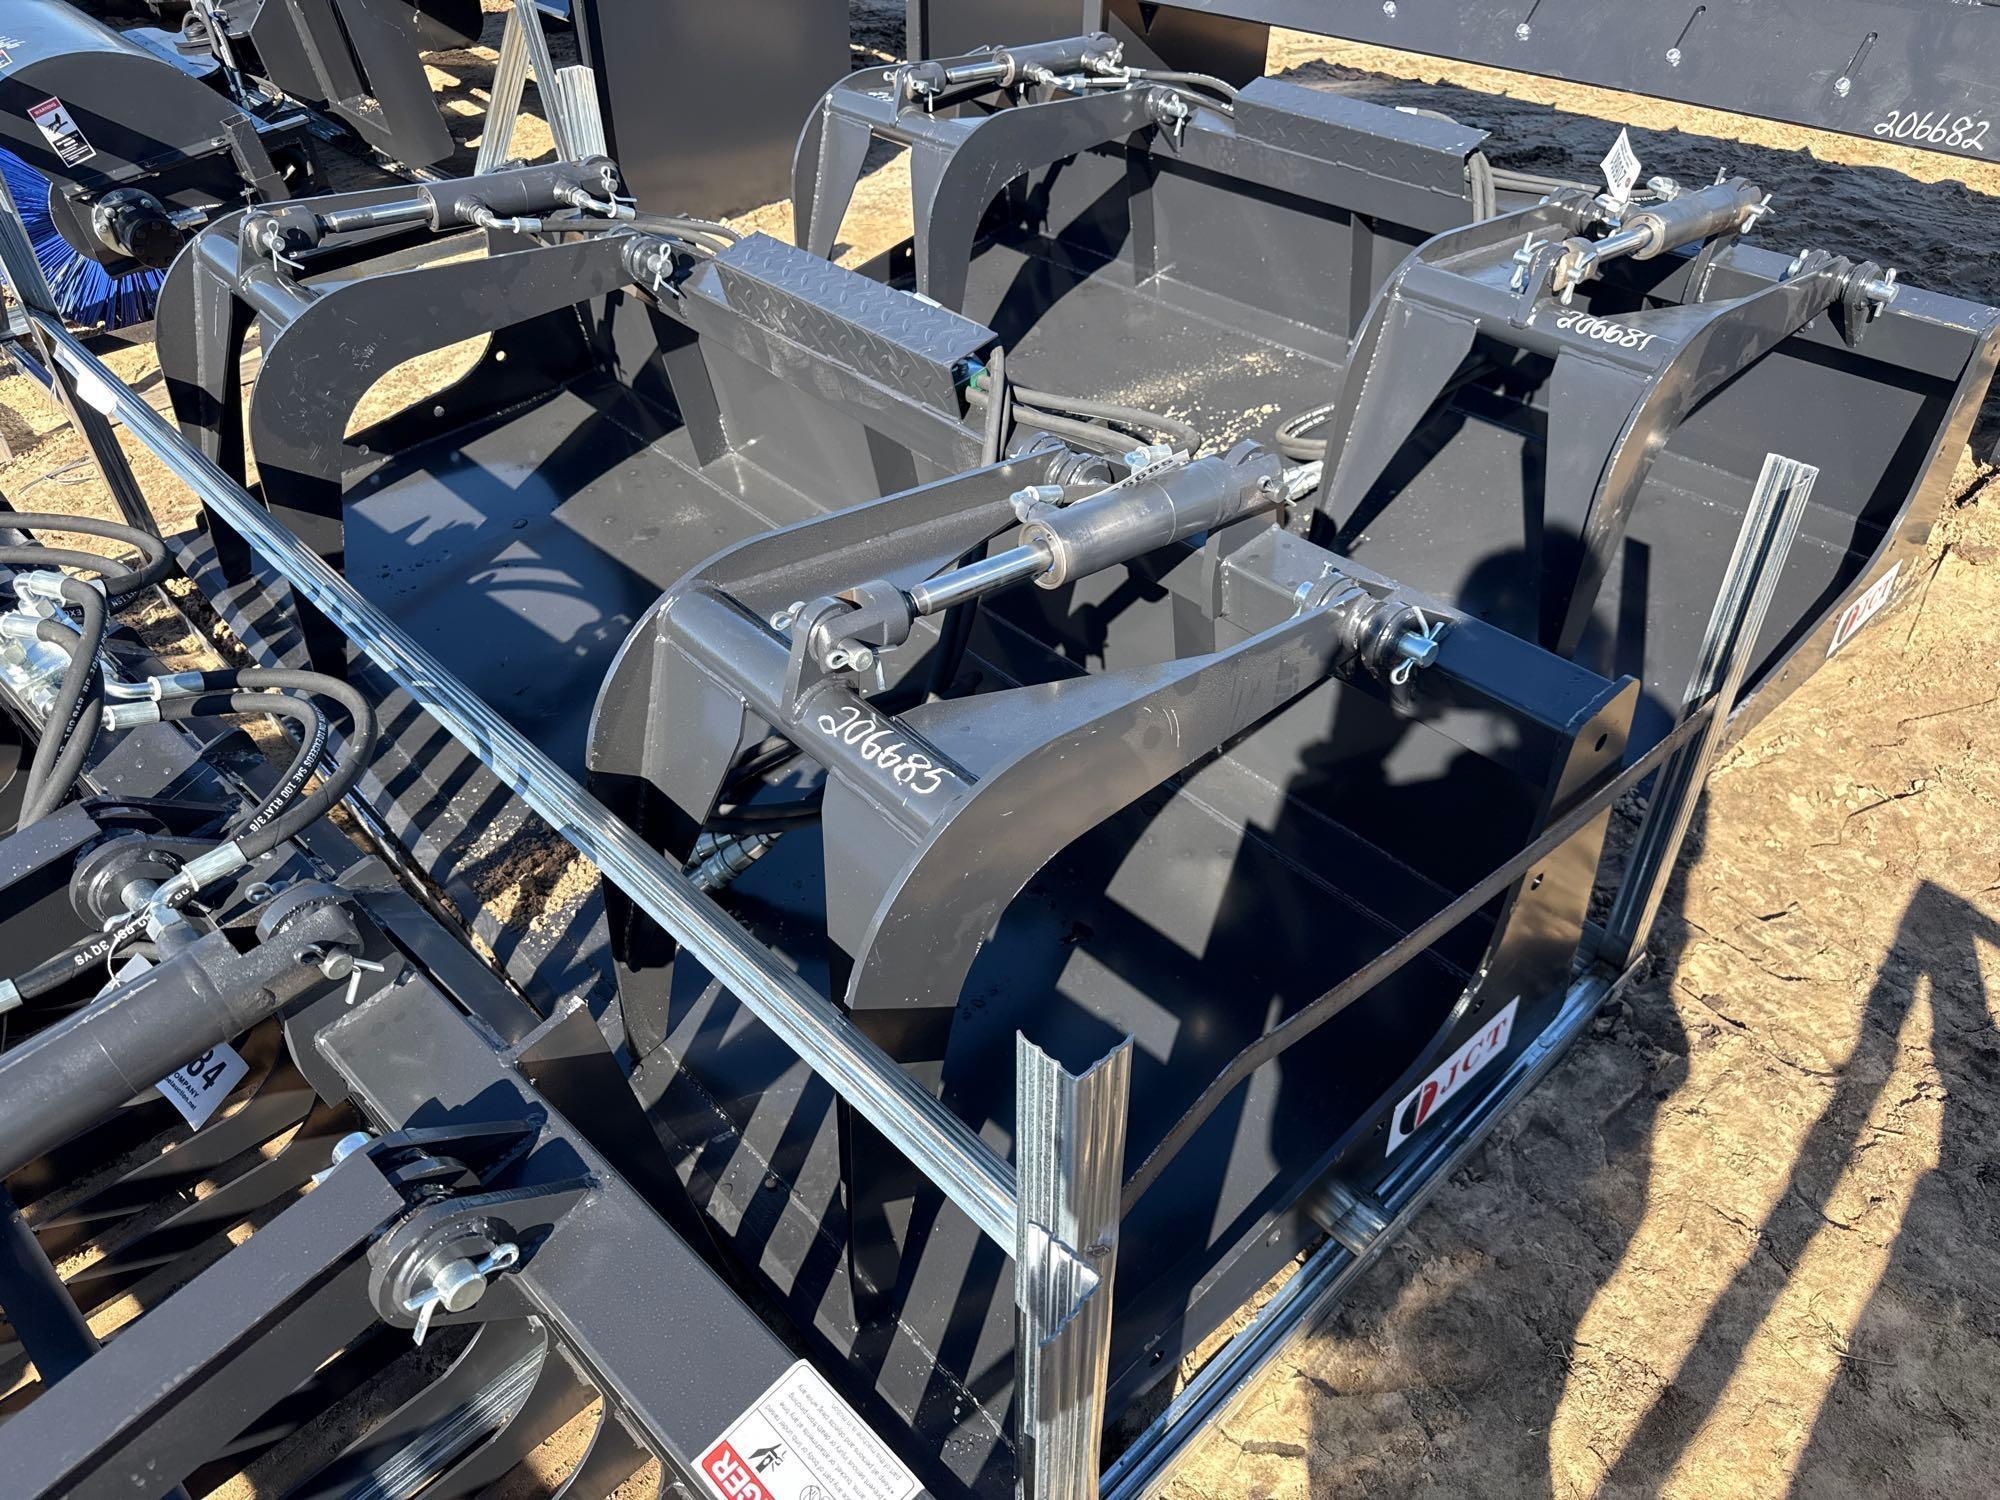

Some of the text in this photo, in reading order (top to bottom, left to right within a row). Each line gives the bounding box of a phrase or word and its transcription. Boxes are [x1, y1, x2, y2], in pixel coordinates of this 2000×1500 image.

[1873, 110, 1990, 151] 206682
[1556, 310, 1657, 351] 206681
[818, 706, 956, 794] 206685
[281, 781, 296, 799] 100
[292, 766, 308, 783] SAE
[1441, 1017, 1507, 1095] JCT
[173, 1071, 200, 1098] OMPANY
